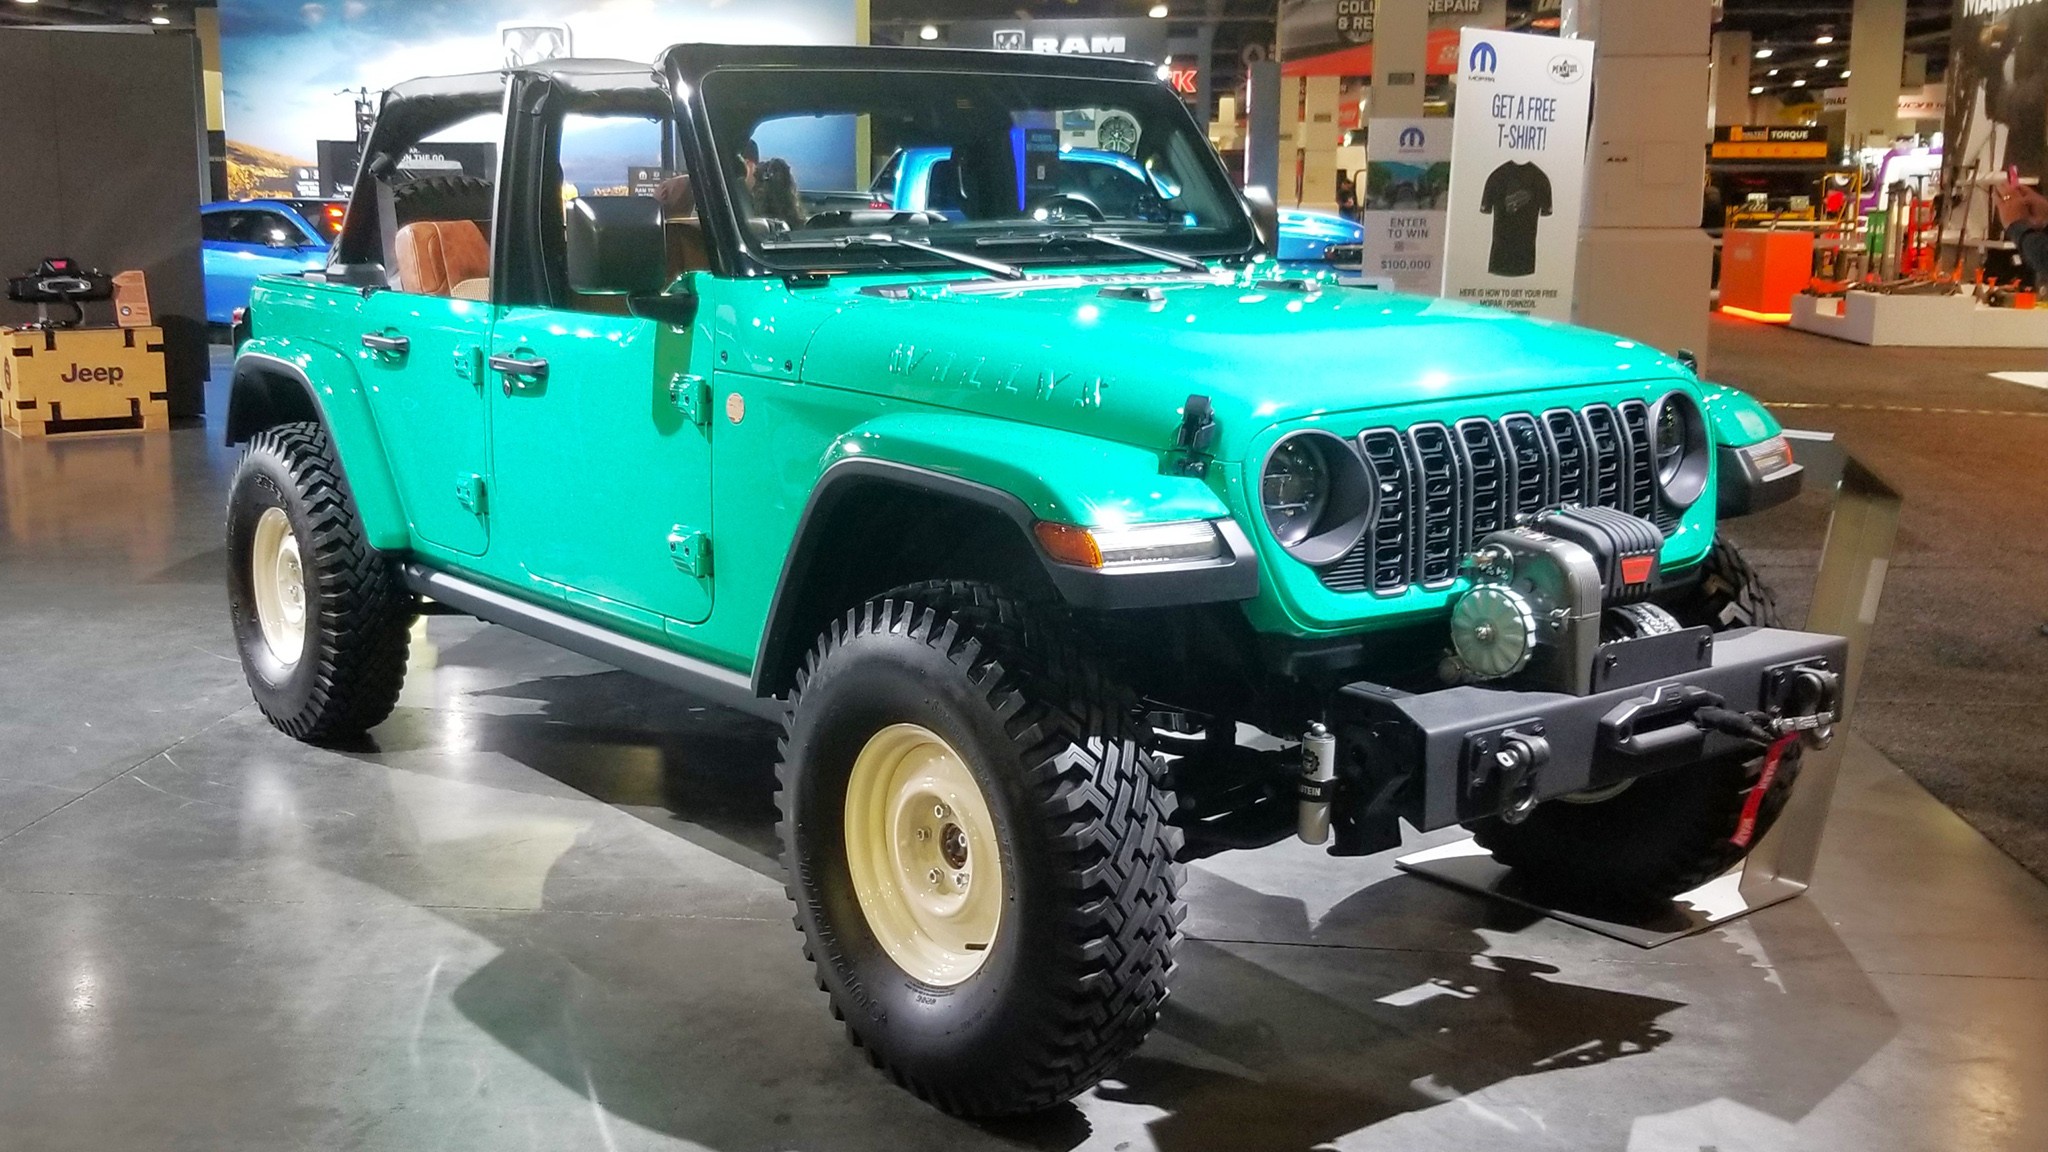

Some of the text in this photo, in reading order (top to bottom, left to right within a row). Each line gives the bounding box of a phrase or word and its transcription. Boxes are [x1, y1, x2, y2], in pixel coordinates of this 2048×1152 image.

[1032, 37, 1126, 54] RAM
[1492, 93, 1557, 122] GET A FREE
[1498, 123, 1547, 151] T-SHIRT!
[1770, 130, 1809, 140] TORQUE
[1390, 218, 1427, 228] ENTER
[1388, 229, 1429, 239] TO WIN
[1381, 260, 1431, 270] $100,000
[1459, 288, 1558, 298] HERE IS HOW TO GET YOUR FREE
[61, 363, 124, 385] Jeep
